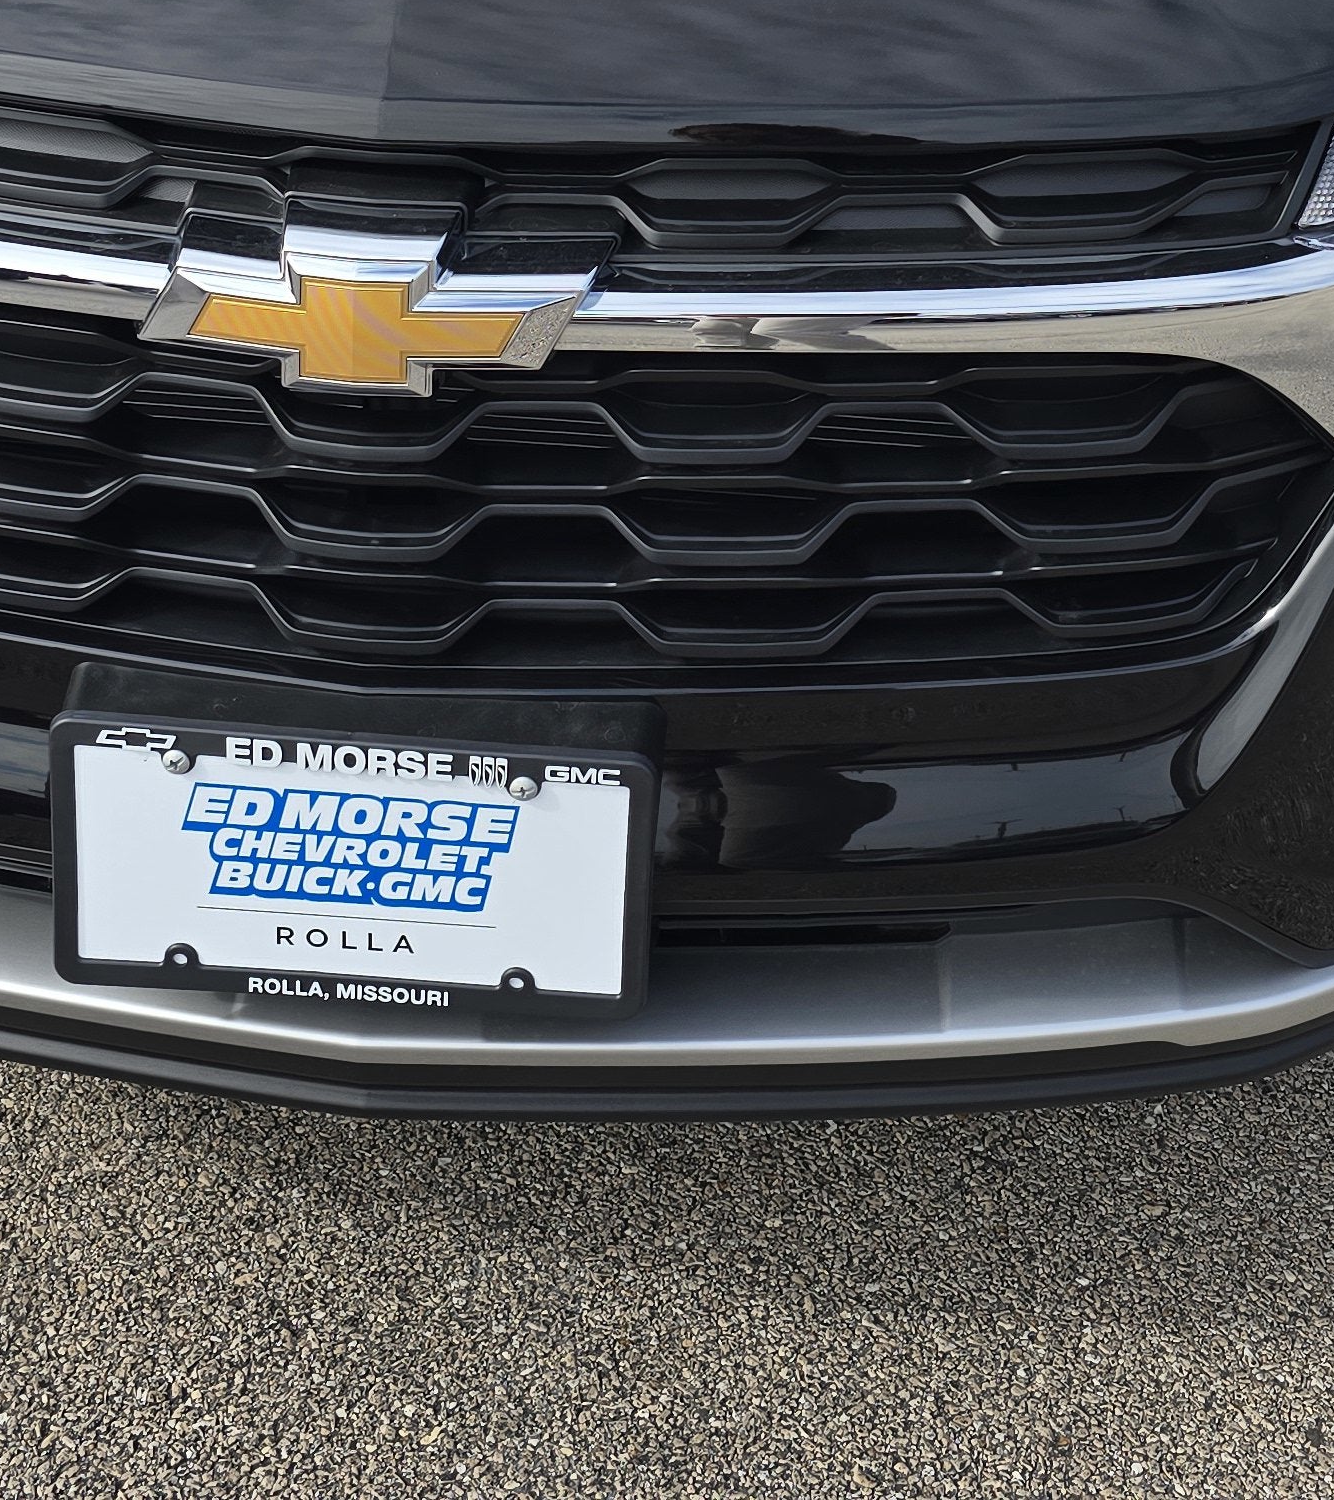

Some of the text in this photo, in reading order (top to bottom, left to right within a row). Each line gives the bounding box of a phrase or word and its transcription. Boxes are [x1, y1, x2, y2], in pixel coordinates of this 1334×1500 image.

[225, 736, 454, 782] ED MORSE
[544, 765, 621, 786] GMC
[186, 787, 516, 844] ED MORSE
[212, 828, 489, 875] CHEVROLET
[276, 926, 415, 954] ROLLA
[248, 976, 450, 1007] ROLLA, MISSOURI
